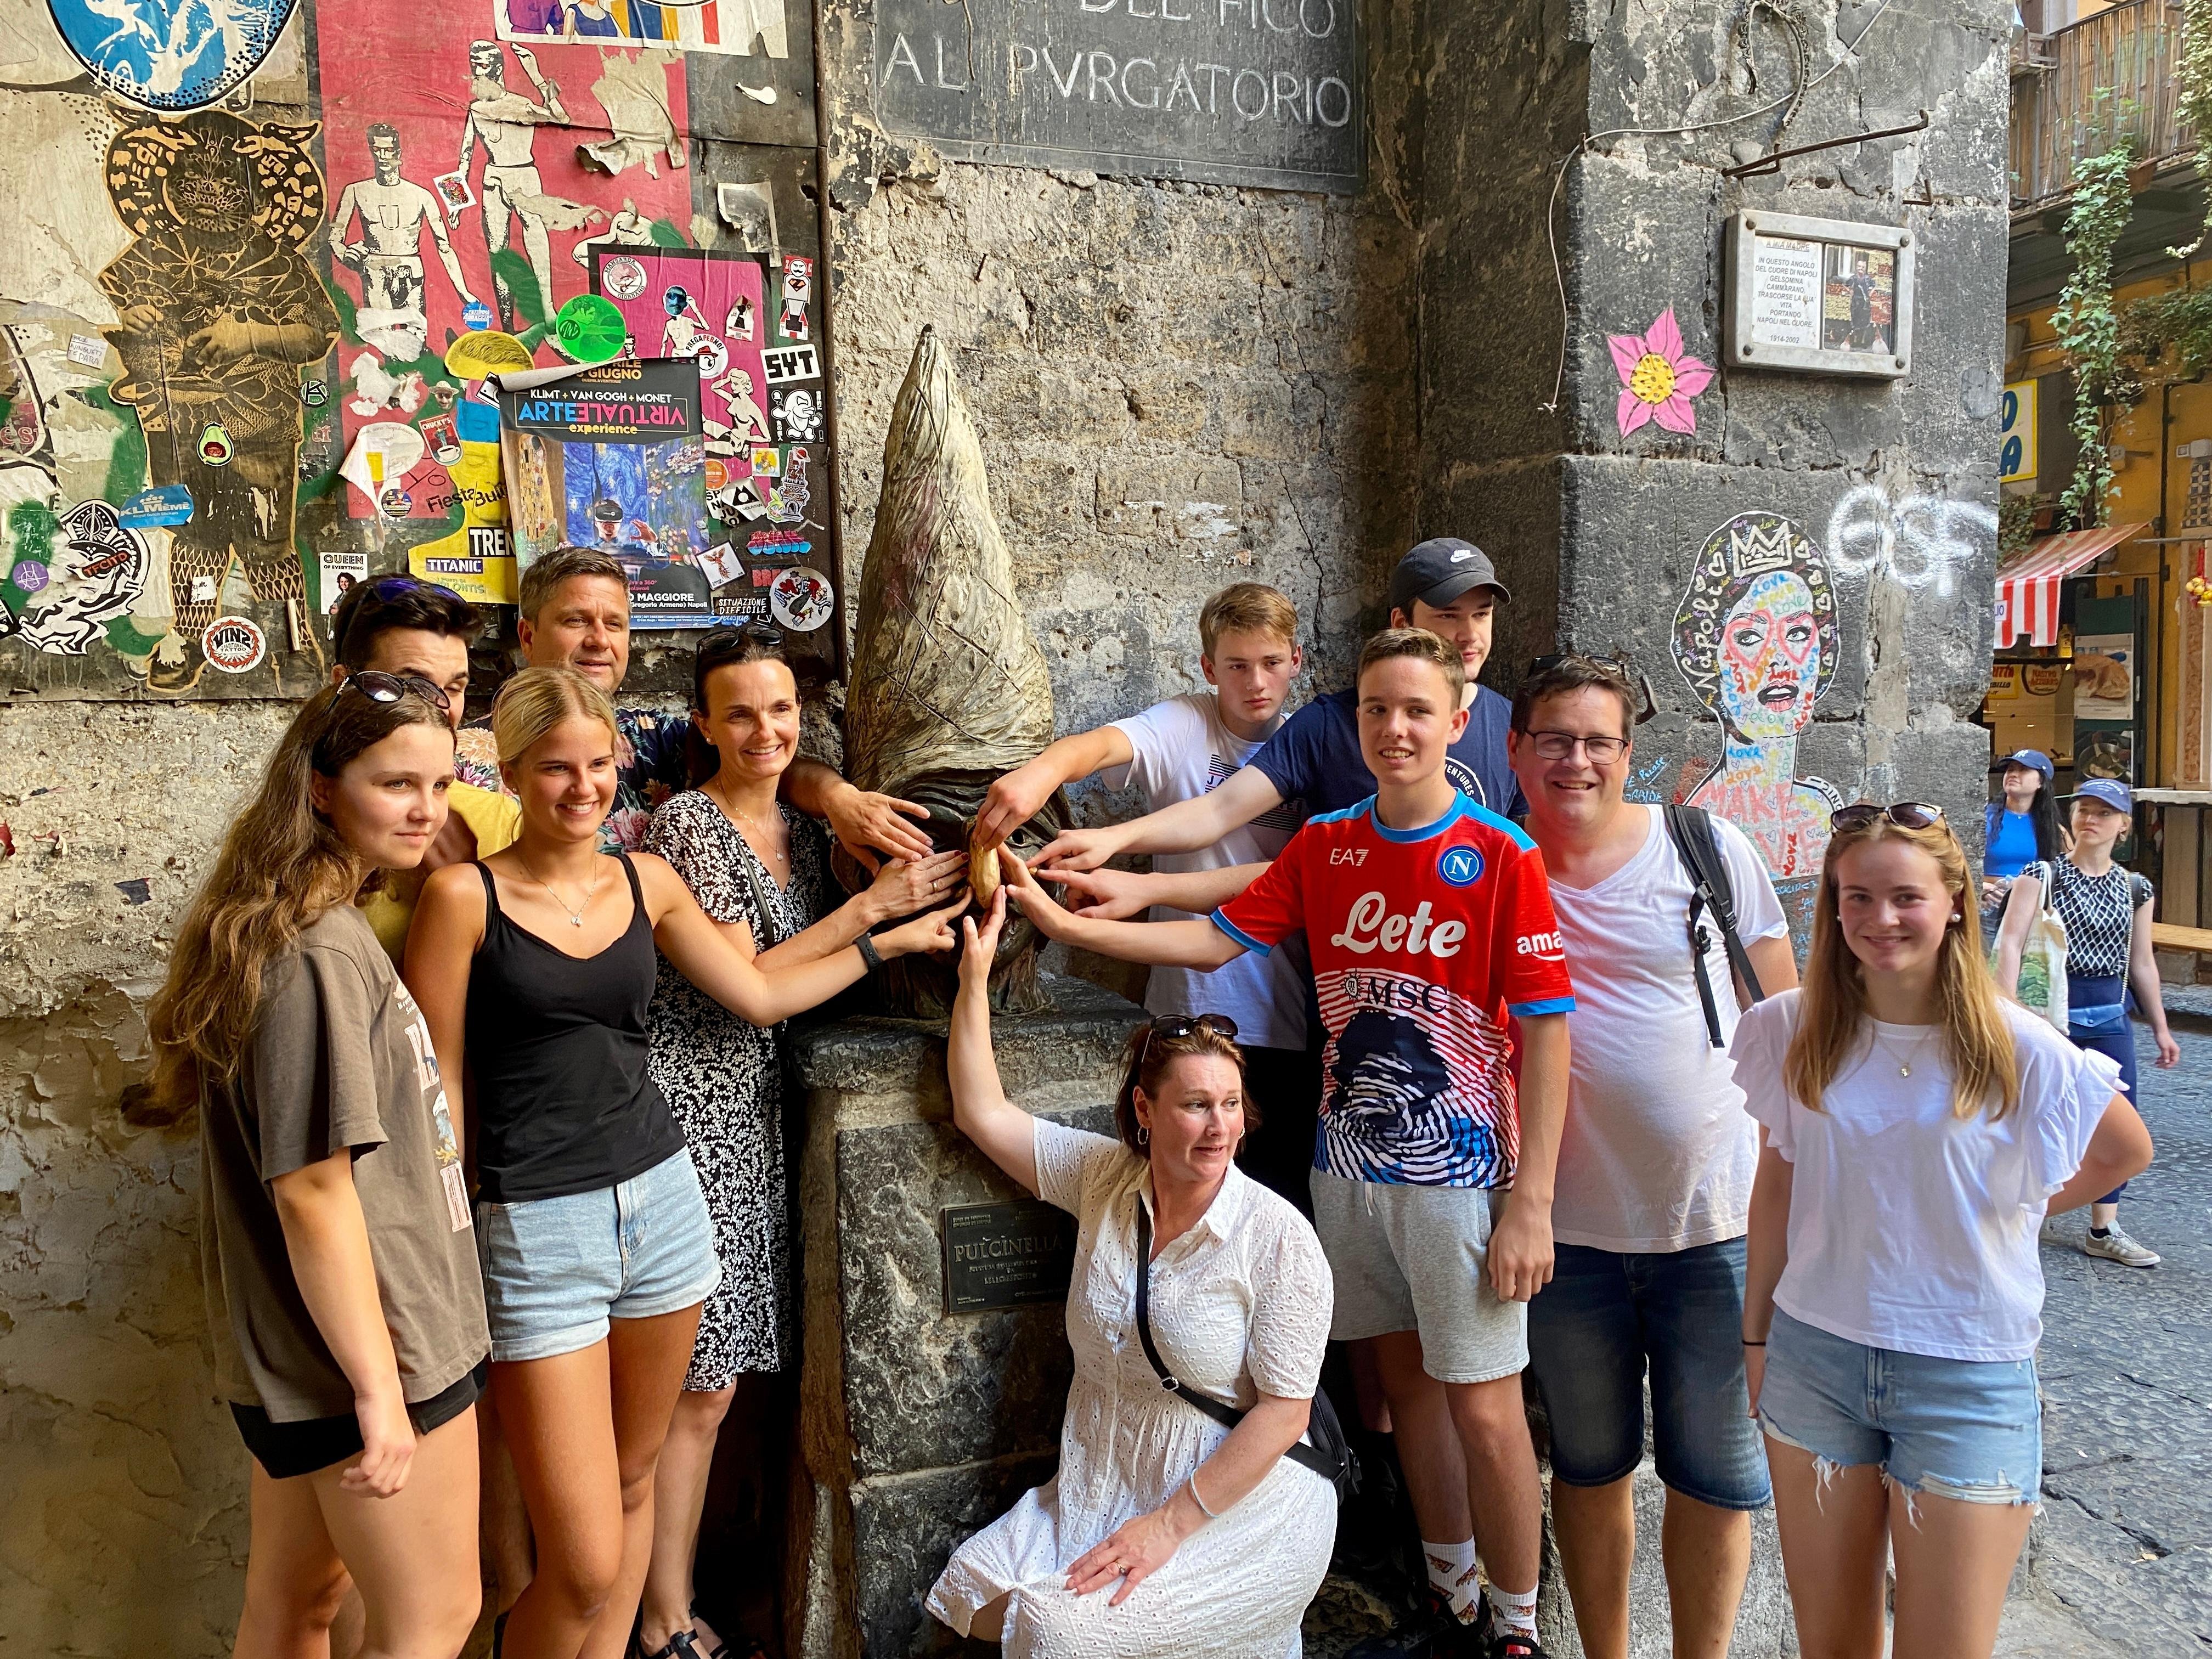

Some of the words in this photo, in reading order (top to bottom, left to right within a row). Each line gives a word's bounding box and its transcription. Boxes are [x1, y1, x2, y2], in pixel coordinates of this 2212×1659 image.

[881, 32, 968, 91] AL
[1008, 44, 1351, 127] PVRGATORIO
[1787, 242, 1810, 251] MADRE
[1765, 258, 1790, 266] QUESTO
[1791, 261, 1815, 269] ANGOLO
[1768, 266, 1788, 274] CUORE
[1797, 269, 1818, 278] NAPOLI
[1770, 275, 1803, 284] GELSOMINA
[1758, 291, 1793, 301] TRASCORSE
[1770, 309, 1801, 318] PORTANDO
[1757, 317, 1780, 325] NAPOLI
[1770, 335, 1800, 344] 1914-2002
[765, 350, 813, 379] SYT
[588, 368, 642, 380] GIUGNO
[530, 389, 560, 399] KLIMT
[570, 390, 593, 400] VAN
[595, 392, 627, 402] GOGH
[636, 393, 672, 403] MONET
[518, 401, 577, 422] ARTE
[422, 417, 451, 431] CHUCKY'S
[568, 424, 638, 435] experience
[324, 554, 364, 565] QUEEN
[427, 558, 482, 573] TITANIC
[637, 592, 695, 602] MAGGIORE
[718, 597, 767, 607] SITUAZIONE
[719, 606, 767, 615] DIFFICILE
[1330, 848, 1369, 867] EA7
[1449, 855, 1472, 877] N
[1331, 891, 1466, 958] Lete
[1364, 976, 1448, 1013] MSC
[954, 1235, 1063, 1262] PULCINELLA
